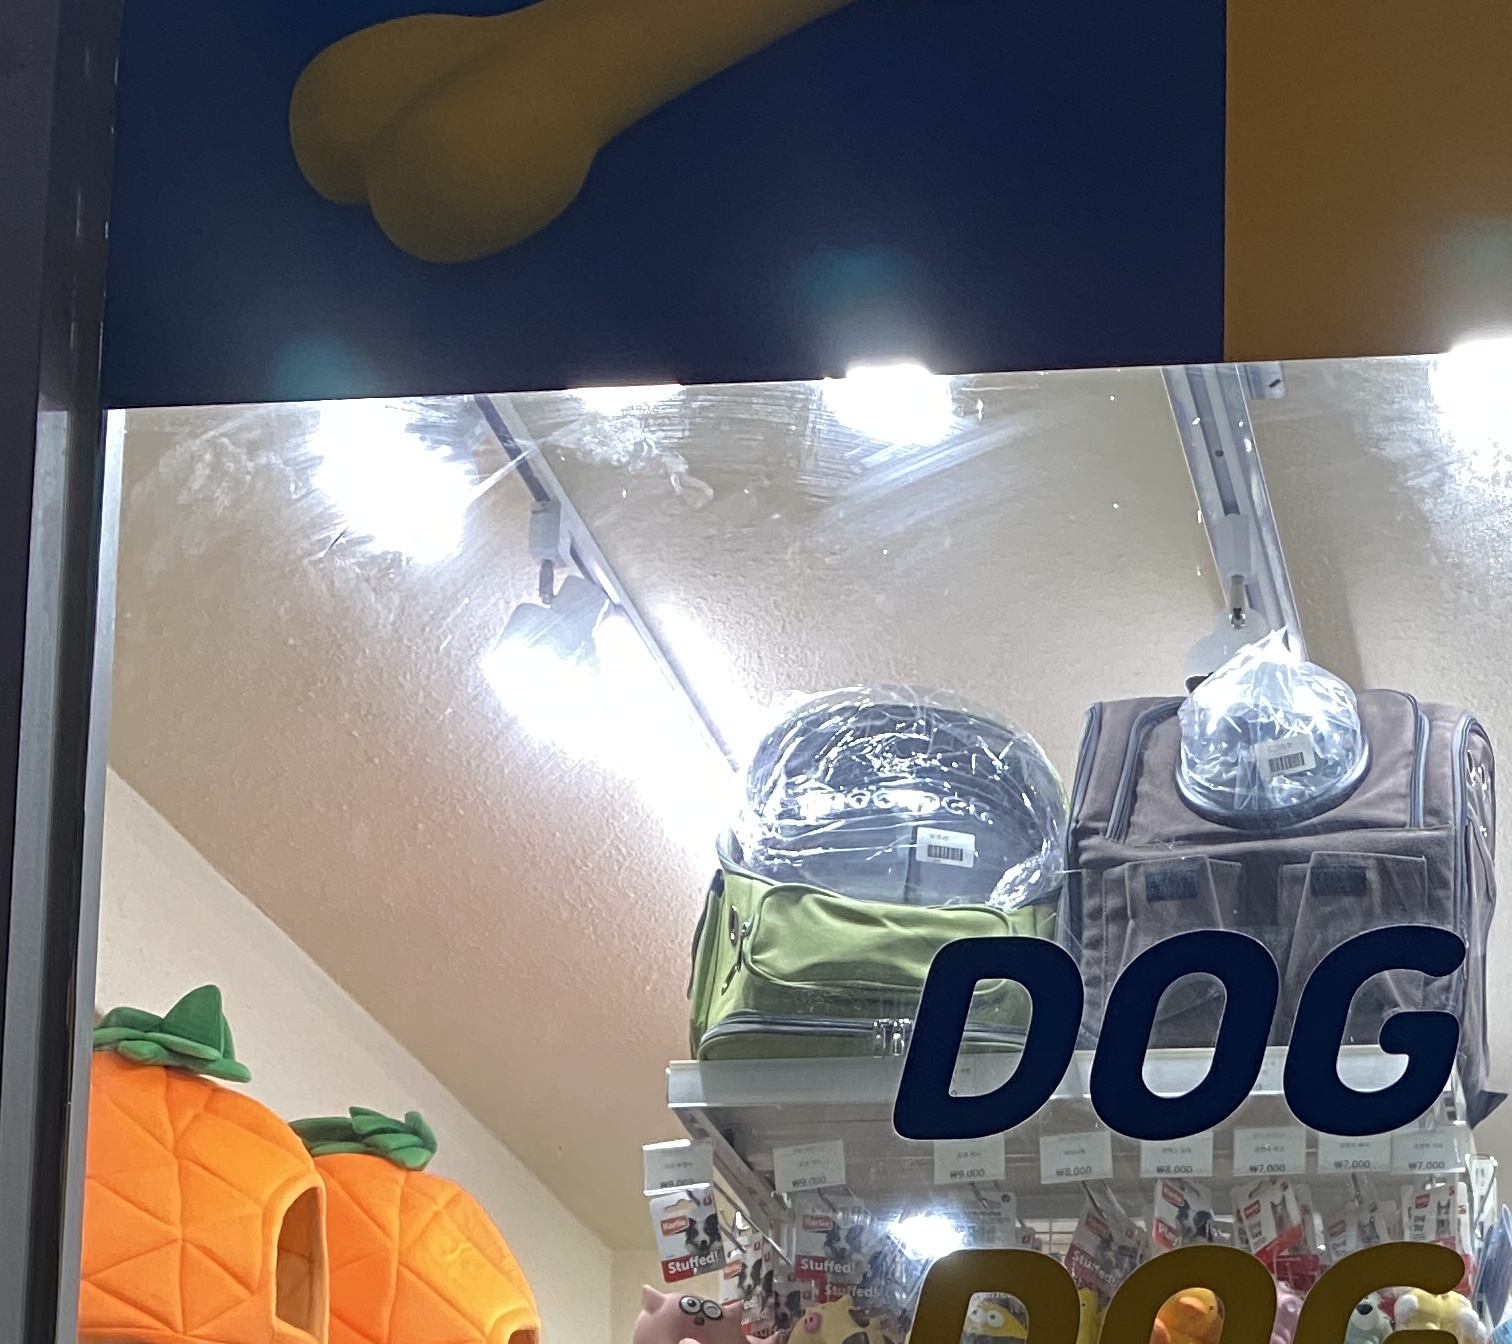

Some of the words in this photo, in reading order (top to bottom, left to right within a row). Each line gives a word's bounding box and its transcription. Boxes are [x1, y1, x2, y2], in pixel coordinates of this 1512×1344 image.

[893, 924, 1466, 1140] DOG
[668, 1250, 718, 1275] Stuffed!
[800, 1257, 855, 1274] Stuffed!
